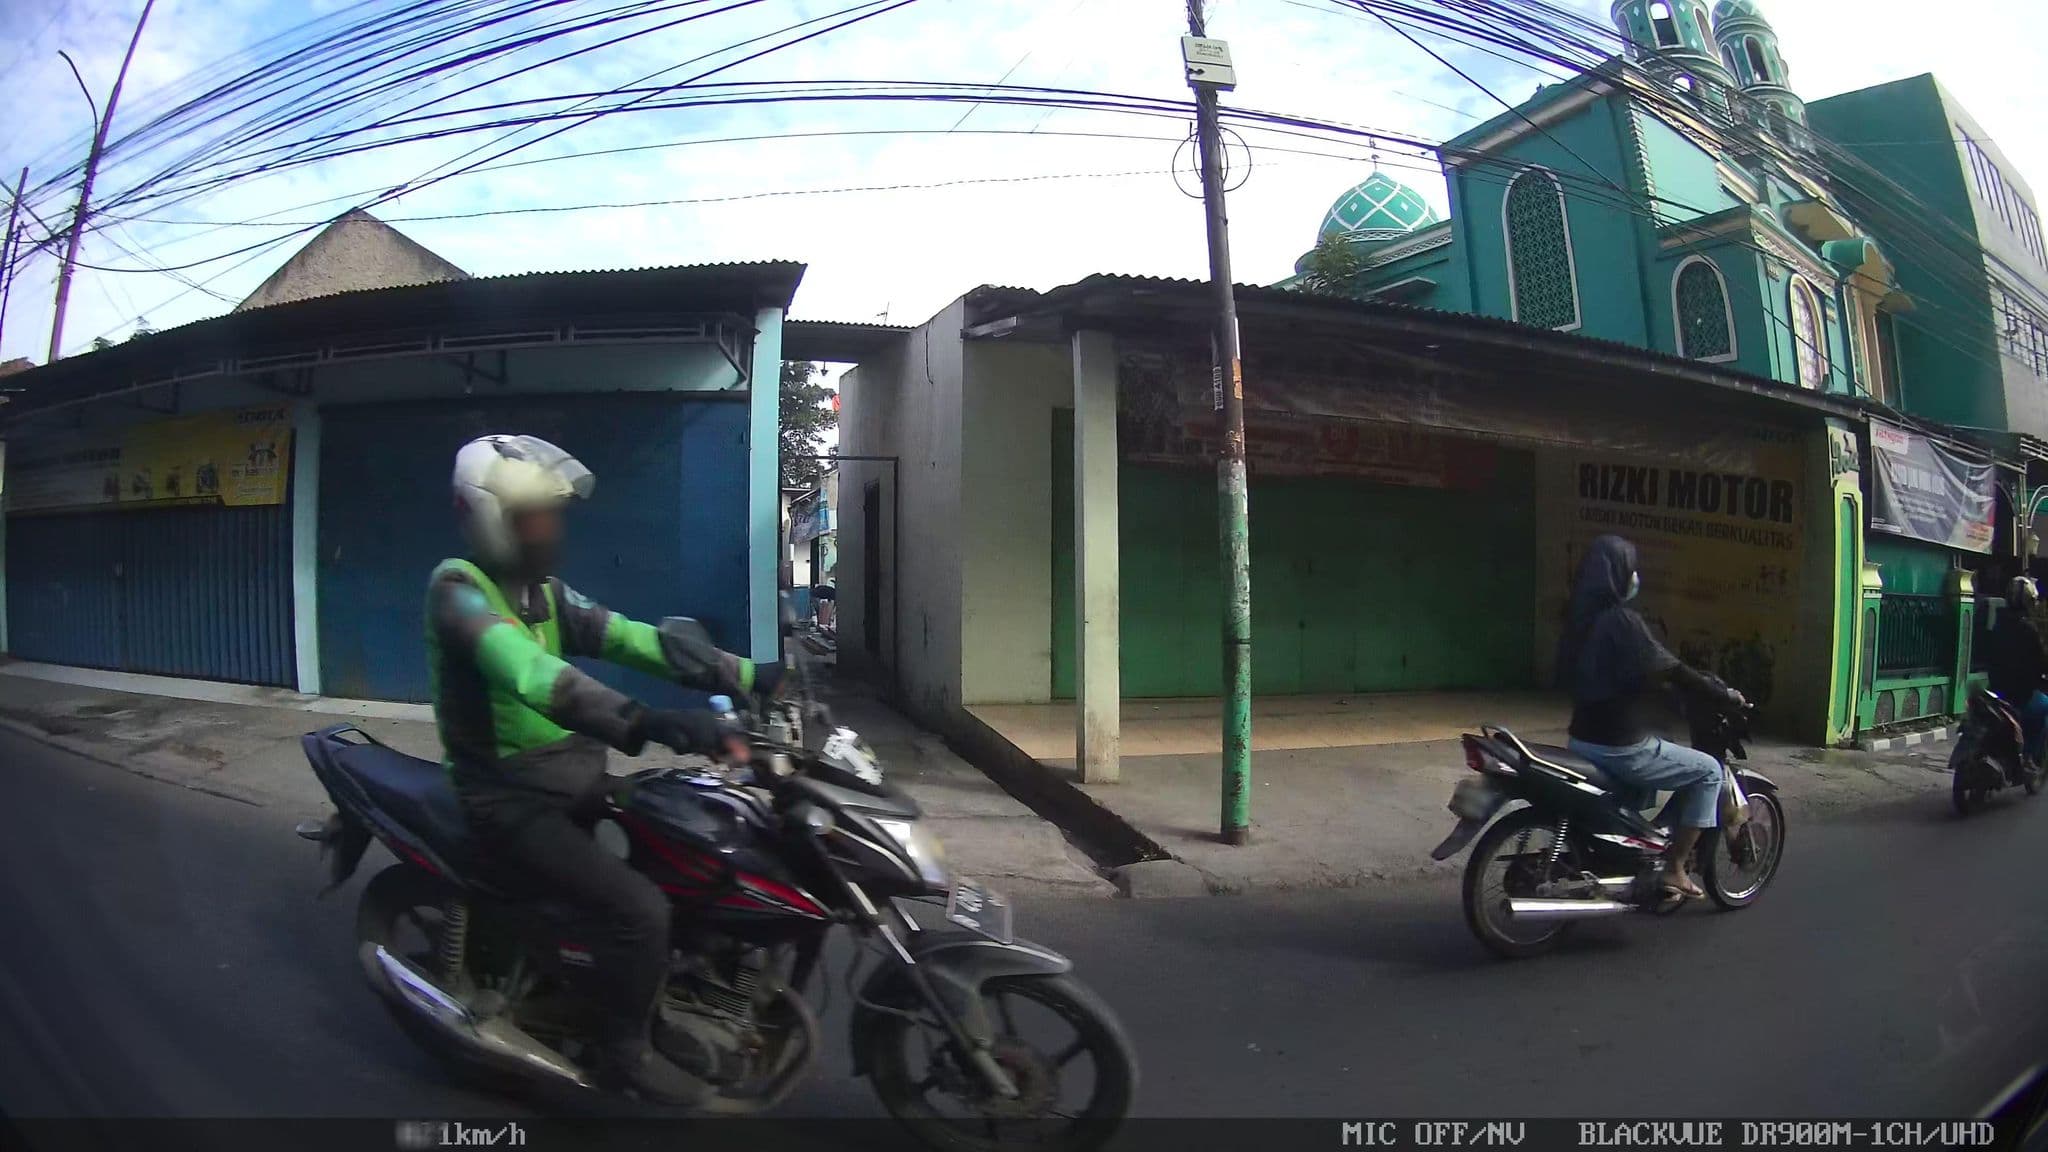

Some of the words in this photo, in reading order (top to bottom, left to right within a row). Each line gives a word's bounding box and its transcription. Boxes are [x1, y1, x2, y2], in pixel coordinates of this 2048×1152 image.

[1579, 463, 1659, 506] RIZKI
[1667, 470, 1794, 524] MOTOR
[1619, 511, 1661, 530] MOTOR
[1706, 522, 1793, 551] BERKUALITAS
